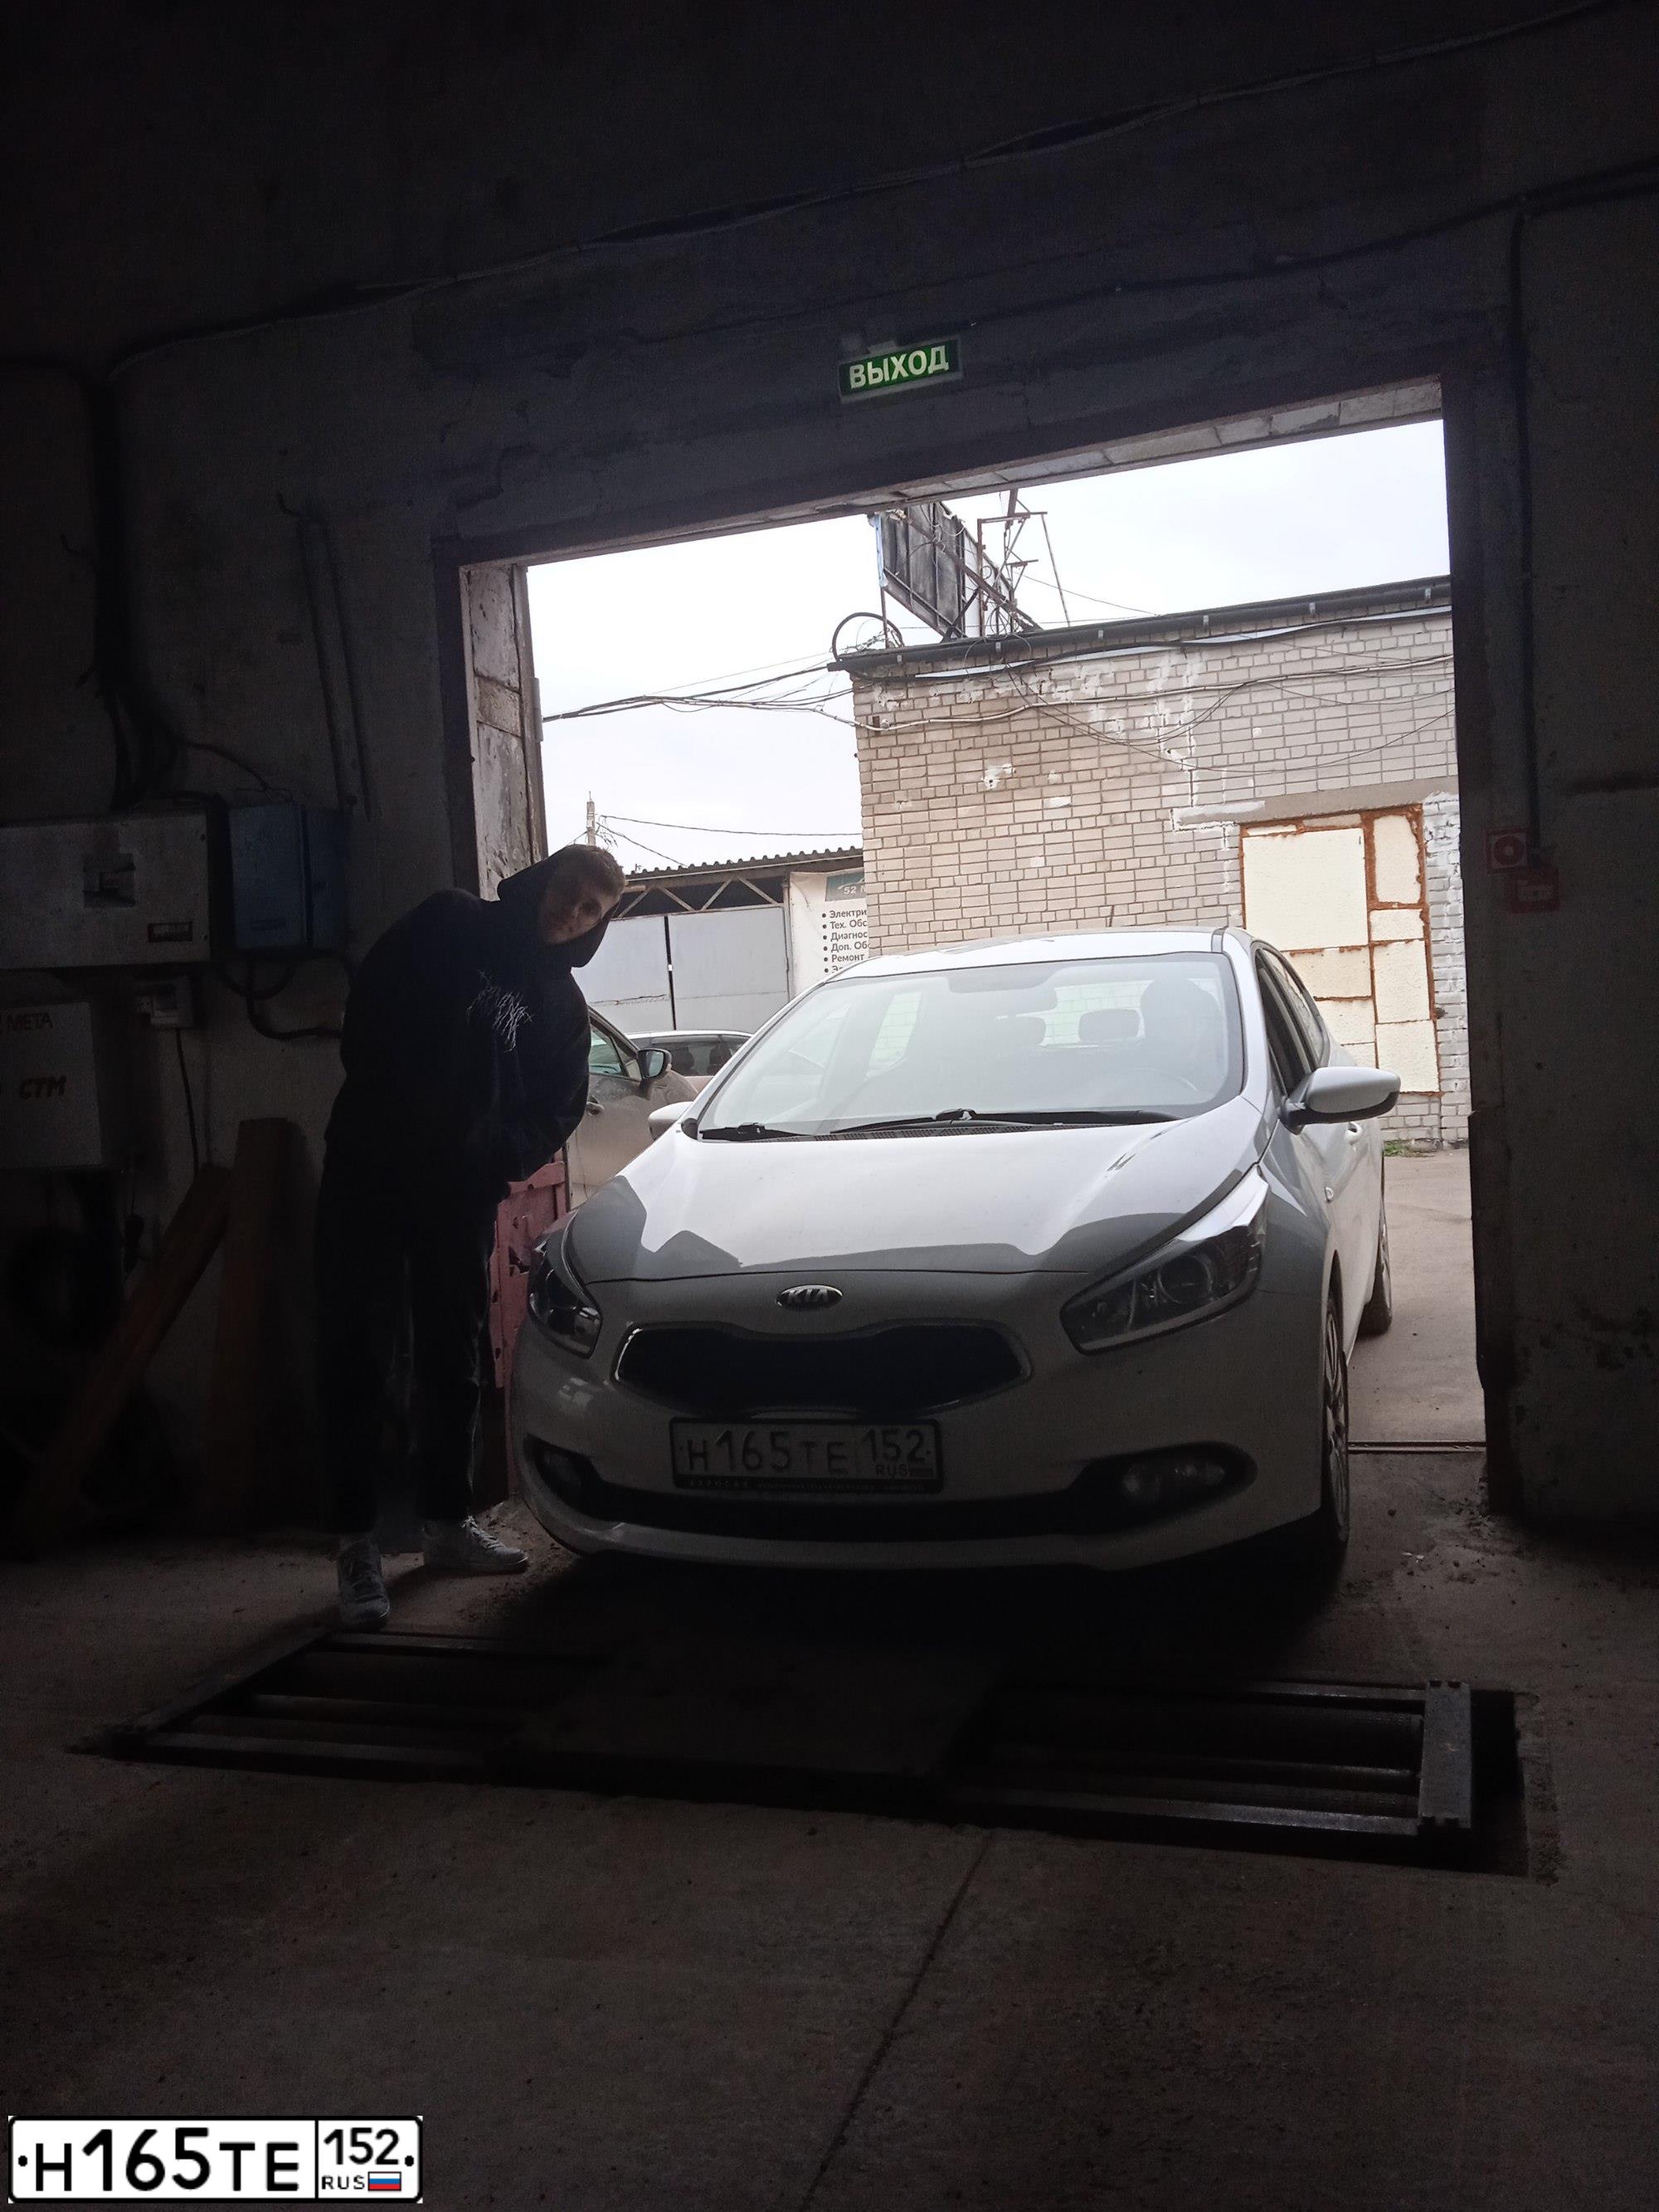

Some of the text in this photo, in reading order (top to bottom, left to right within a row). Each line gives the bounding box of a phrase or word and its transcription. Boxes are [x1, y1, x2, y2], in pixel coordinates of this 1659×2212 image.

[849, 344, 950, 389] ВЫХОД
[830, 909, 867, 918] Электри
[830, 919, 867, 929] Тех. Обс
[830, 931, 868, 943] Диагнос
[830, 943, 852, 953] Доп.
[831, 953, 864, 962] Ремонт
[787, 1288, 830, 1303] KIA
[860, 1428, 926, 1463] 152
[875, 1464, 908, 1477] RUS
